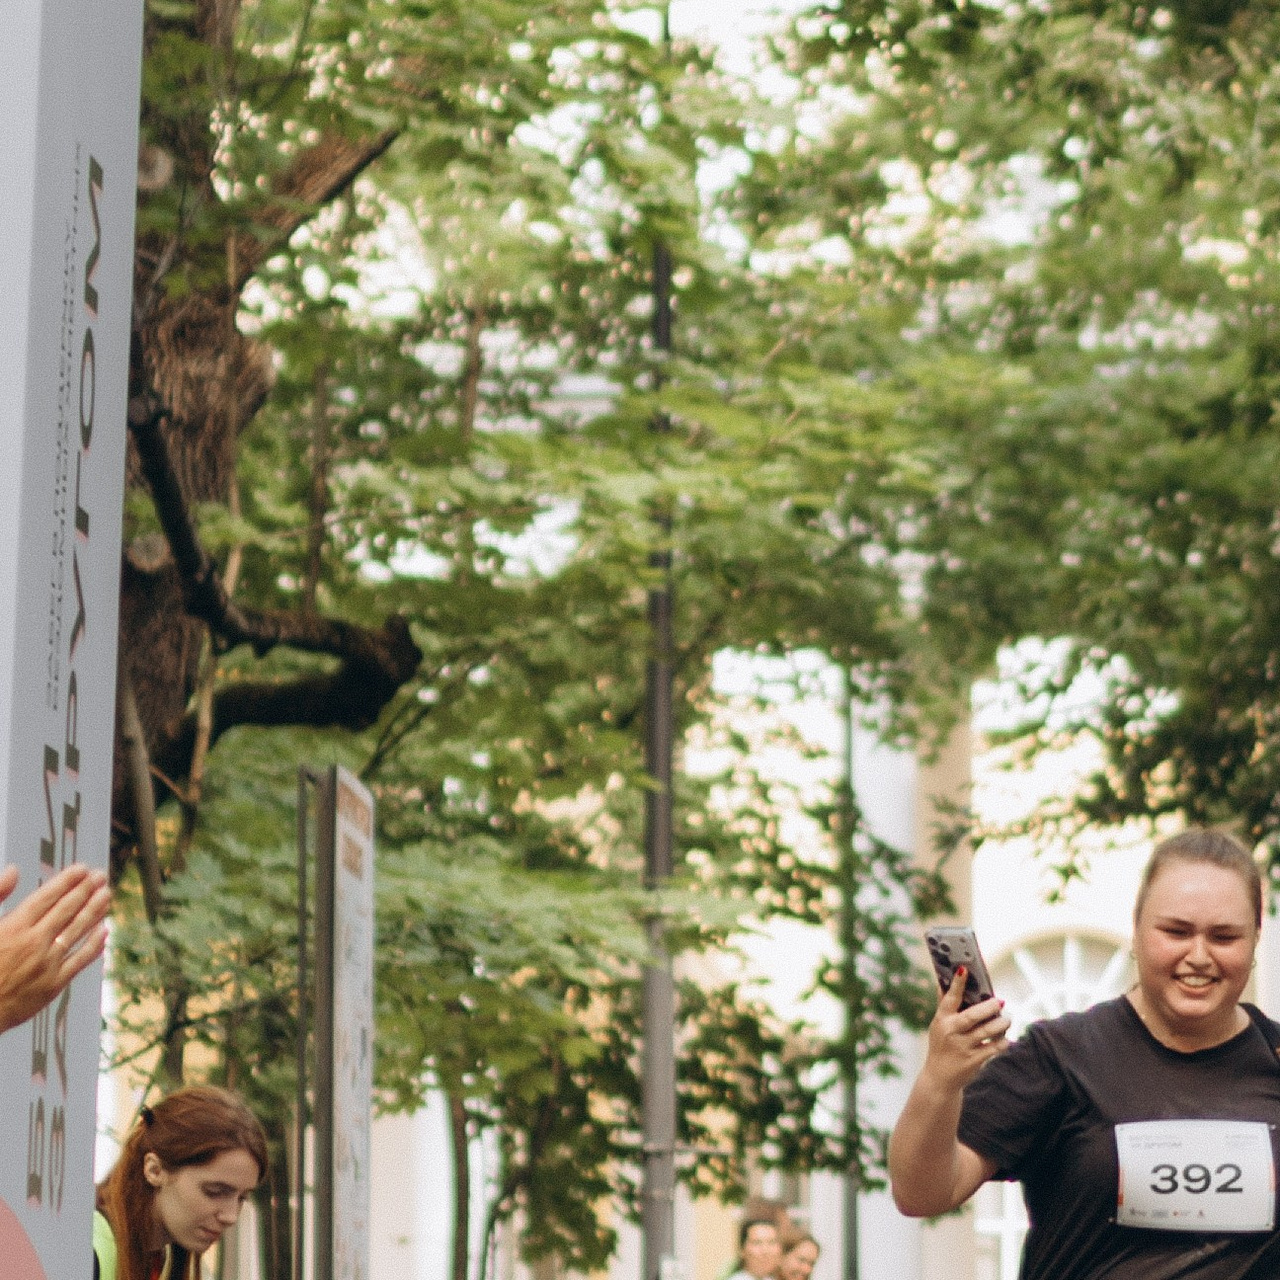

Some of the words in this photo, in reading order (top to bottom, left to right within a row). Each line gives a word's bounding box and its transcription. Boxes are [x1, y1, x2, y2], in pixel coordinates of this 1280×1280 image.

[48, 980, 71, 1216] ЗА
[60, 154, 103, 870] ДРУГОМ
[27, 744, 59, 1209] БЕИ
[1150, 1163, 1244, 1195] 392
